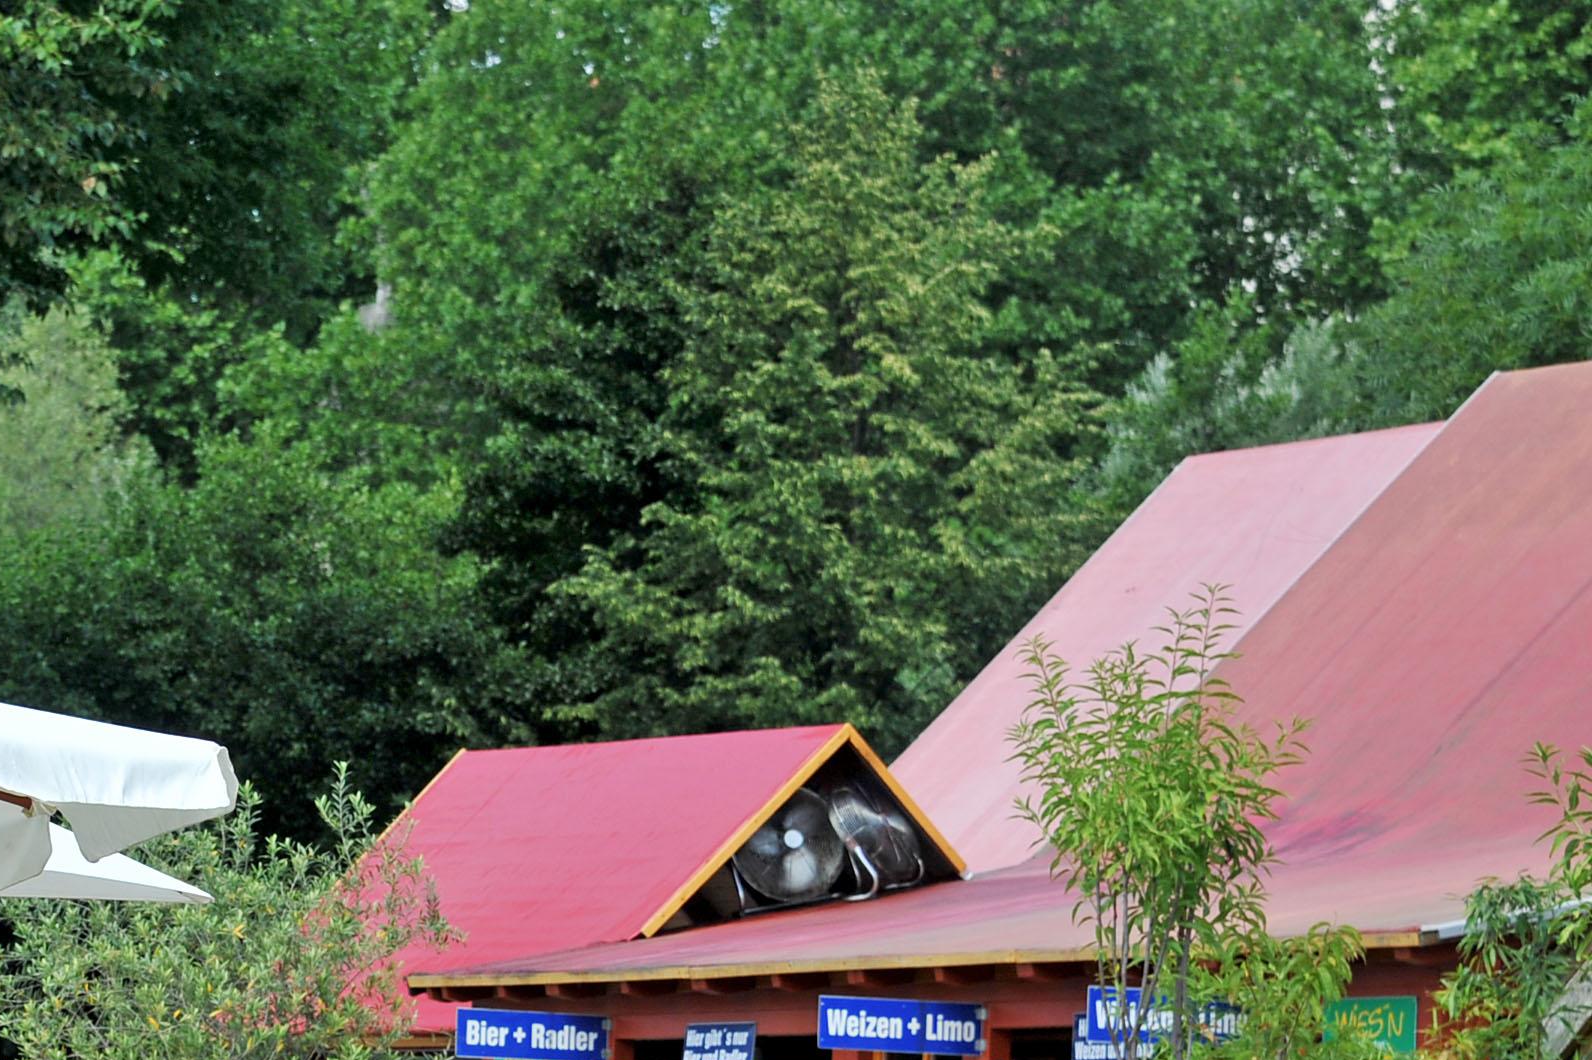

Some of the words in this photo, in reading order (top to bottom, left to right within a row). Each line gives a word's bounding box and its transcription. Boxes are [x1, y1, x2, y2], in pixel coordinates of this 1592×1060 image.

[826, 1008, 903, 1039] Weizen
[907, 1017, 921, 1035] +
[925, 1013, 976, 1042] Limo
[1095, 1000, 1174, 1032] Wien
[466, 1019, 508, 1047] Bier
[513, 1027, 526, 1043] +
[530, 1023, 598, 1051] Radler
[685, 1029, 705, 1047] Hier
[732, 1031, 749, 1046] nur
[1074, 1041, 1106, 1060] Weizen
